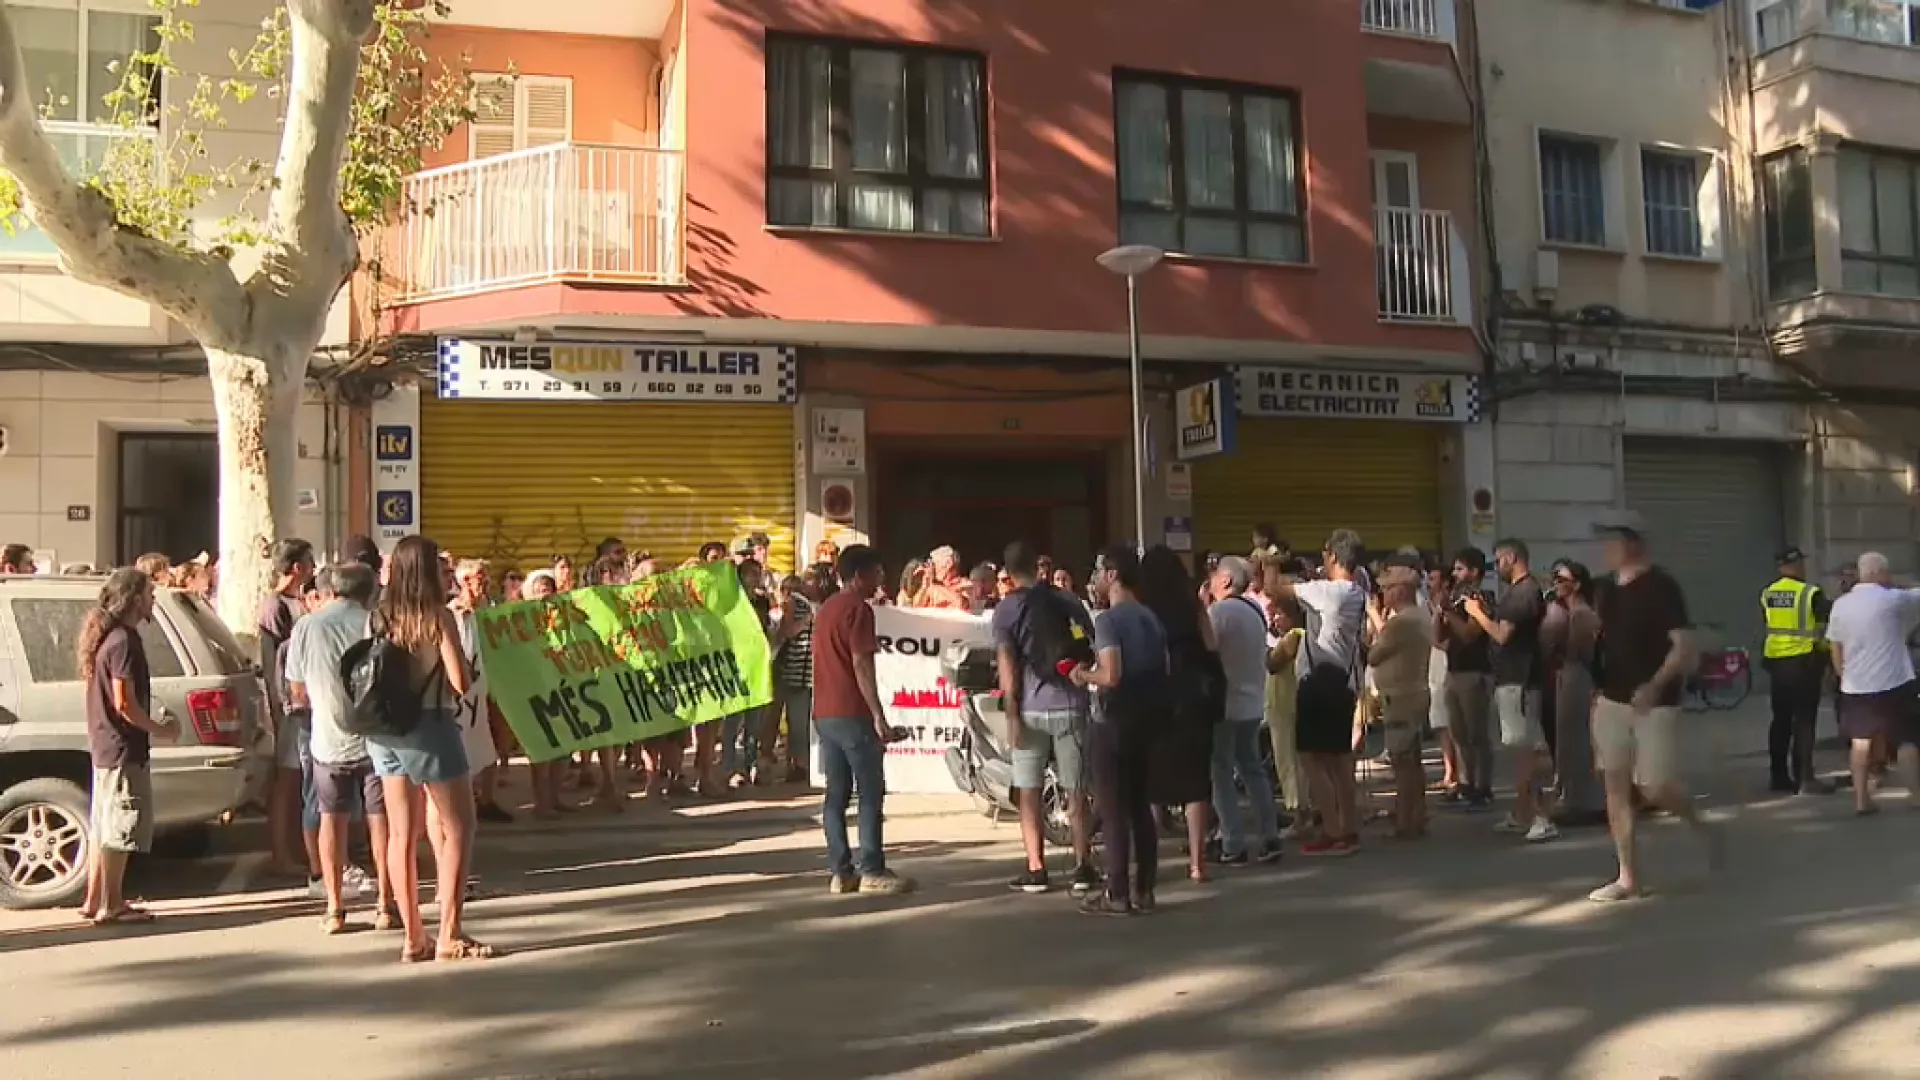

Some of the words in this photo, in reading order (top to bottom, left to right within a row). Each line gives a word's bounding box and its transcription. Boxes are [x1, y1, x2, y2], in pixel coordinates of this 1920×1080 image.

[634, 349, 760, 375] TALLER
[503, 380, 530, 391] 971
[1257, 371, 1400, 393] MECANICA
[1259, 393, 1400, 415] ELECTRICITAT
[381, 433, 408, 453] itv
